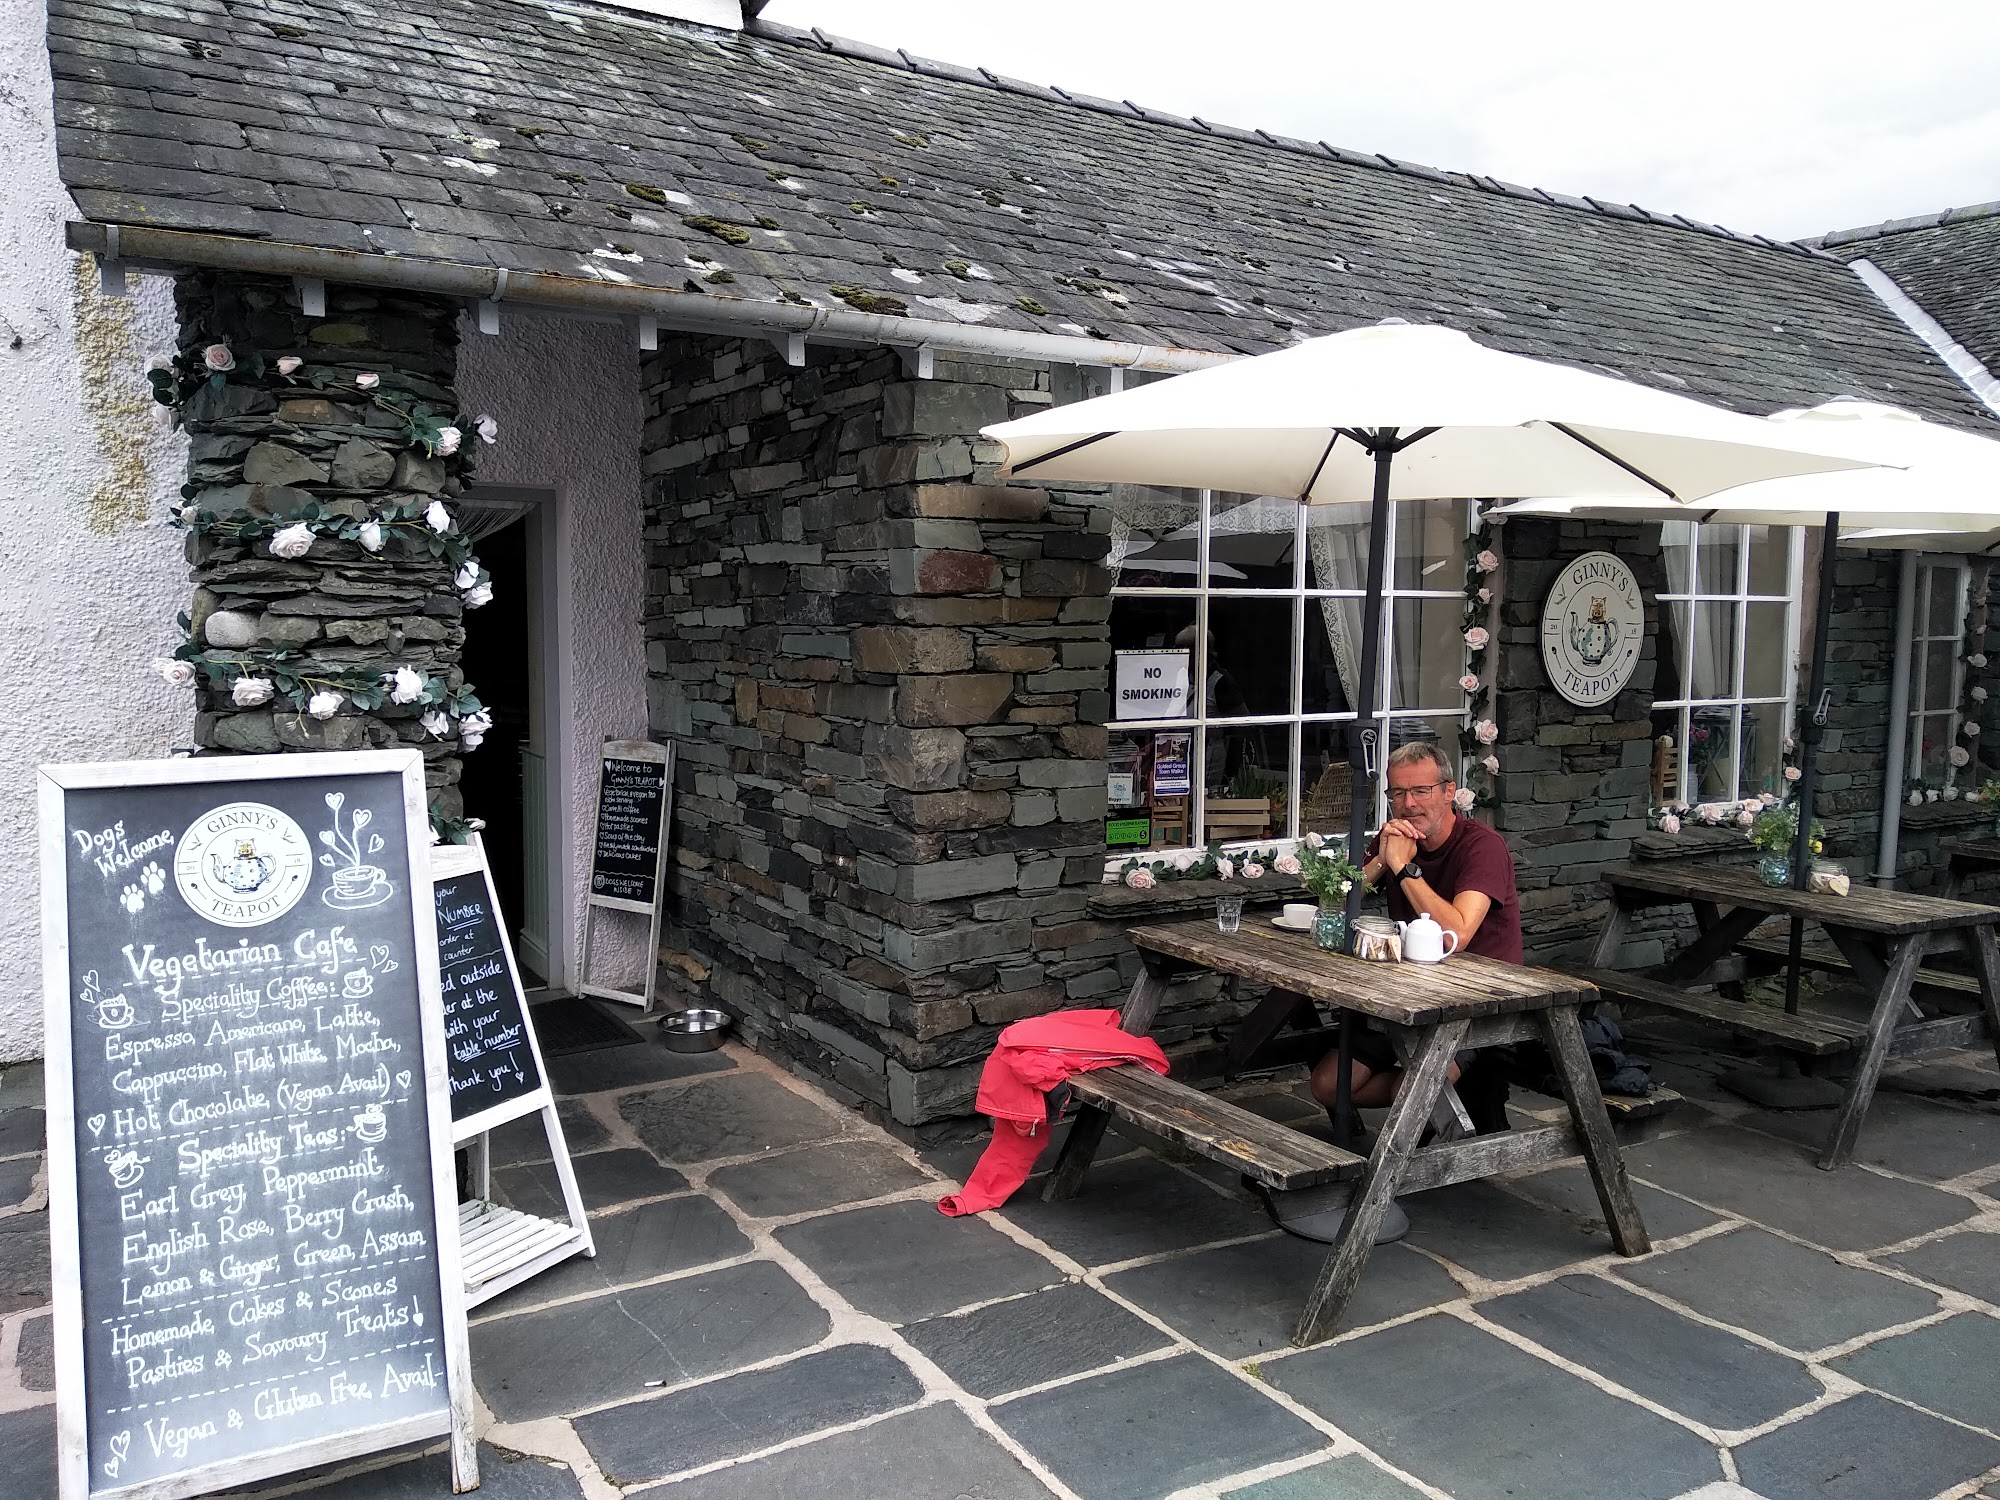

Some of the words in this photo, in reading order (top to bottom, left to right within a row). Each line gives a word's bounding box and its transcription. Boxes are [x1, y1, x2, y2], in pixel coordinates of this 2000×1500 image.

[1572, 561, 1629, 592] GINNY'S
[1143, 667, 1162, 679] NO
[1563, 668, 1619, 696] TEAPOT
[1122, 688, 1182, 701] SMOKING
[611, 760, 641, 774] Welcome
[643, 763, 652, 773] to
[635, 777, 658, 785] TEAPOT
[207, 811, 278, 834] GINNY'S
[623, 805, 640, 814] coffee
[630, 816, 648, 824] scones
[72, 820, 125, 854] Dogs
[613, 823, 633, 831] pasties
[634, 833, 645, 844] day
[212, 895, 280, 917] TEAPOT
[436, 886, 457, 906] your
[437, 903, 483, 925] NUMBER
[439, 934, 460, 947] order
[464, 929, 474, 940] at
[121, 938, 282, 995] Vegetarian
[293, 926, 358, 974] Cafe
[444, 944, 475, 961] counter
[460, 959, 503, 985] outside
[161, 983, 261, 1024] Speciality
[461, 993, 474, 1010] at
[475, 988, 498, 1005] the
[204, 1020, 305, 1046] Americano,
[445, 1017, 469, 1039] with
[473, 1009, 500, 1040] your
[453, 1039, 481, 1060] table
[484, 1024, 521, 1048] number
[113, 1062, 226, 1103] Cappuccino,
[234, 1046, 275, 1075] Flat
[448, 1068, 485, 1096] Thank
[113, 1105, 161, 1137] Hot
[277, 1078, 333, 1112] (Vegan
[337, 1062, 391, 1097] Avail)
[178, 1129, 282, 1178] Speciality
[121, 1186, 180, 1221] Earl
[122, 1222, 209, 1275] English
[217, 1215, 274, 1244] Rose,
[283, 1204, 344, 1238] Berry
[121, 1277, 192, 1306] Lemon
[200, 1267, 214, 1285] &
[360, 1227, 426, 1259] Assam
[111, 1310, 214, 1355] Homemade
[228, 1295, 285, 1327] Cakes
[296, 1291, 313, 1309] &
[322, 1276, 398, 1307] Scones
[126, 1348, 205, 1389] Pasties
[215, 1350, 232, 1368] &
[243, 1331, 329, 1363] Savoury
[144, 1417, 218, 1459] Vegan
[227, 1408, 244, 1430] &
[254, 1386, 324, 1421] Gluten
